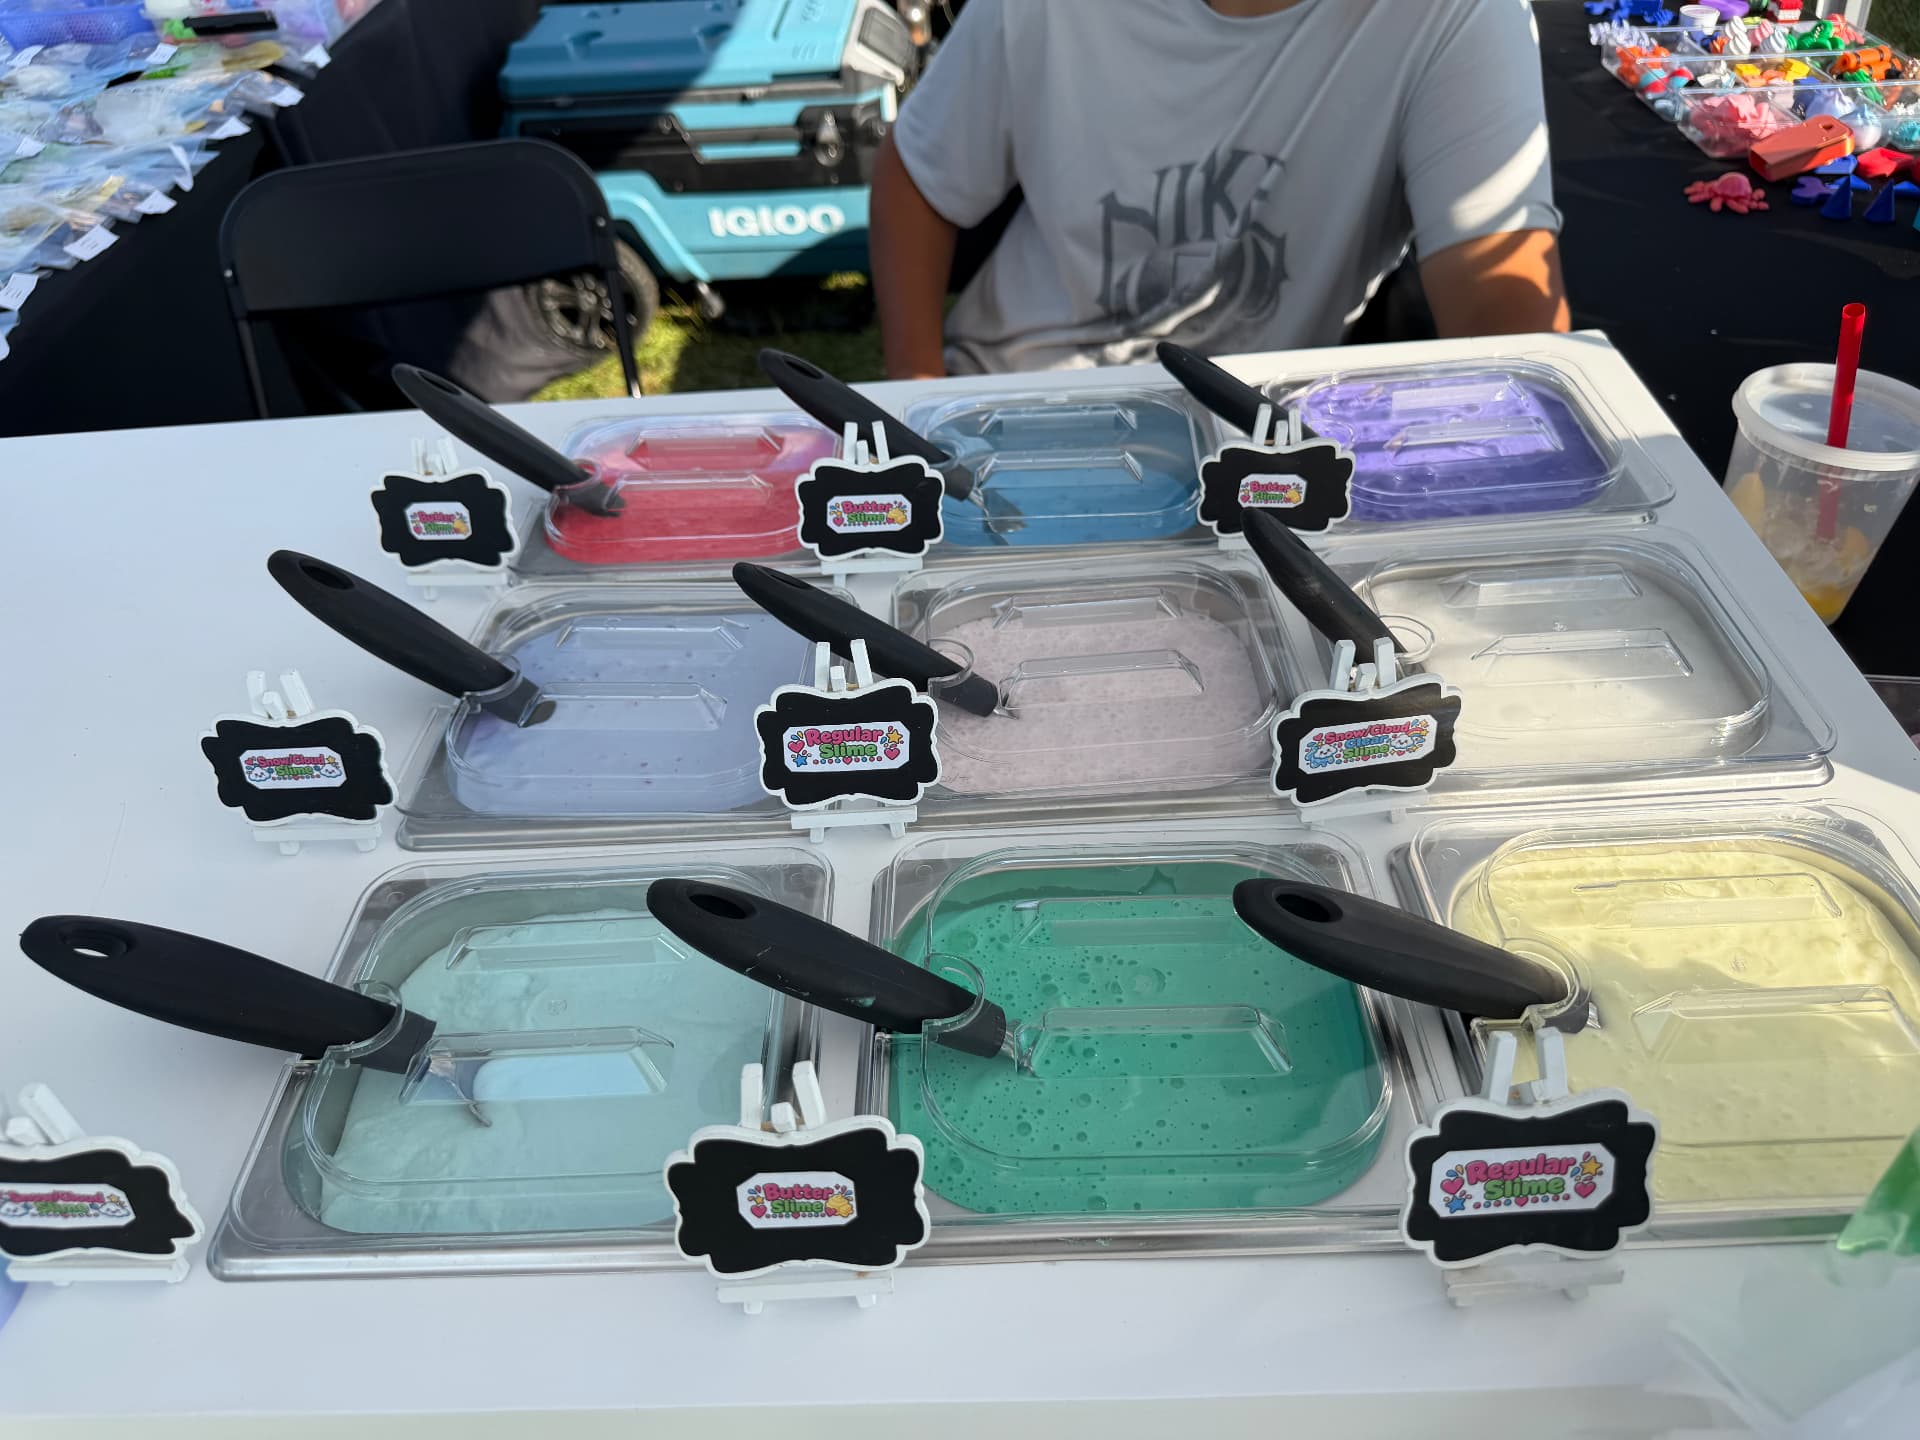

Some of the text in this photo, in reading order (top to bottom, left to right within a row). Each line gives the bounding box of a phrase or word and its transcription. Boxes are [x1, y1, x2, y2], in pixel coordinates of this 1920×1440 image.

[709, 204, 845, 237] IGLOO
[1249, 481, 1292, 493] Butter
[1252, 492, 1284, 501] Slime
[840, 501, 893, 515] Butter
[846, 513, 885, 525] Slime
[803, 727, 884, 748] Regular
[1323, 721, 1411, 745] Snow/Cloud
[1344, 734, 1389, 749] Clear
[818, 742, 878, 760] Slime
[1342, 744, 1390, 759] Slime
[256, 753, 325, 768] Snow/Cloud
[273, 766, 314, 779] Slime
[1465, 1153, 1577, 1185] Regular
[763, 1182, 835, 1203] Butter
[1484, 1176, 1566, 1202] Slime
[771, 1199, 826, 1216] Slime
